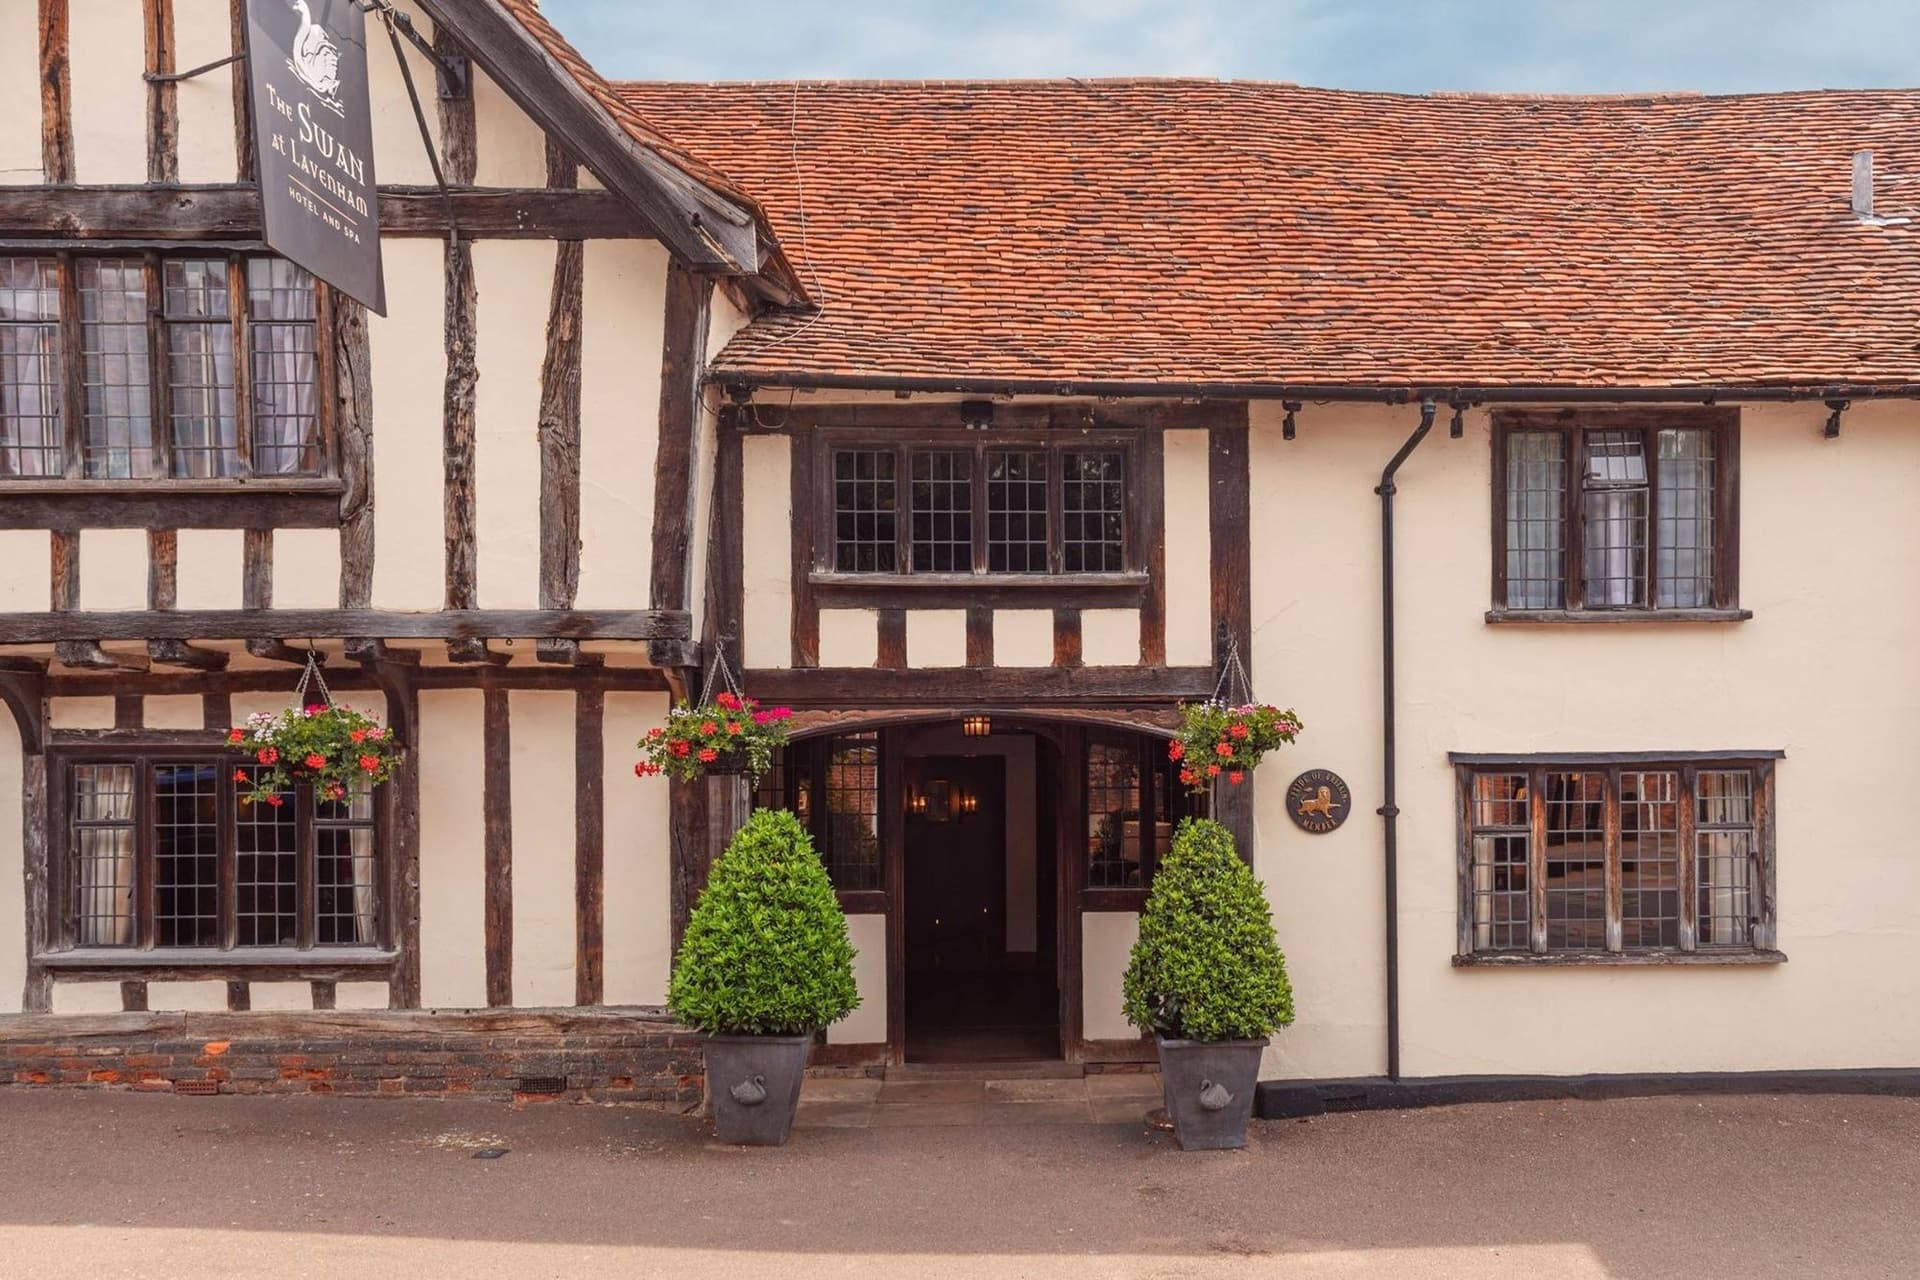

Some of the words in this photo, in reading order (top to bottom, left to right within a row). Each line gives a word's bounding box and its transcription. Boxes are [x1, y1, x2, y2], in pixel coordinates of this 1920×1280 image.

[291, 138, 368, 217] LAVENHAM
[298, 102, 365, 187] SWAN
[289, 187, 319, 216] HOTEL
[323, 212, 341, 230] AND
[344, 226, 360, 244] SPA
